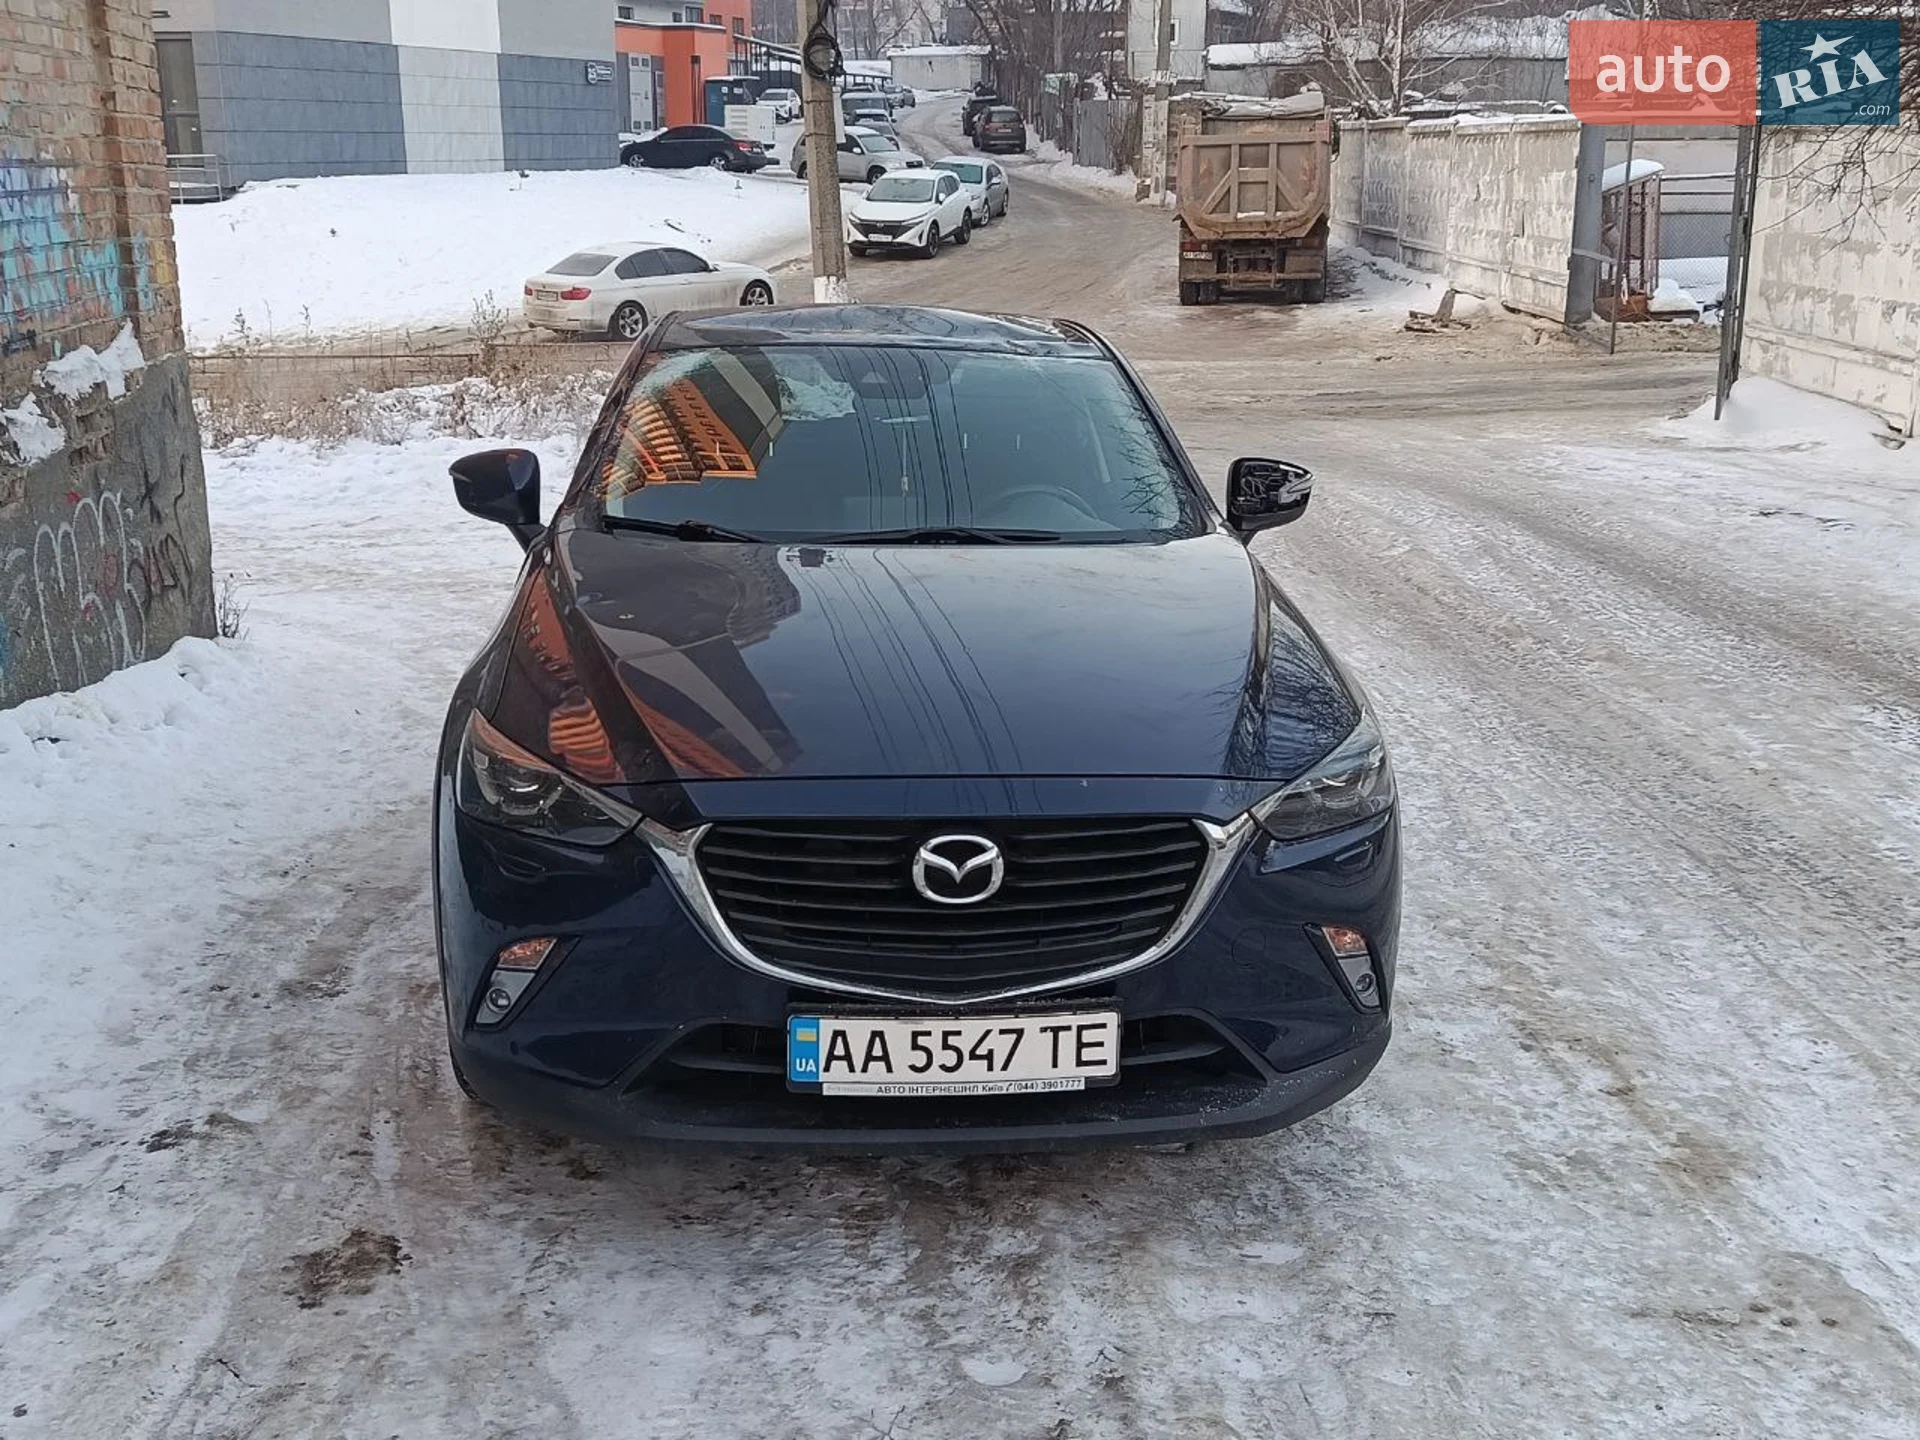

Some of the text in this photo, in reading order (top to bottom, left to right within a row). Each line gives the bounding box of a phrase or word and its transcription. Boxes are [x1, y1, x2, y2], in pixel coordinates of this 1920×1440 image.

[823, 1022, 1108, 1074] AA 5547 TE
[795, 1058, 817, 1073] UA
[876, 1085, 906, 1095] АВТО
[1013, 1081, 1039, 1092] (044)
[1041, 1079, 1083, 1090] 3901777
